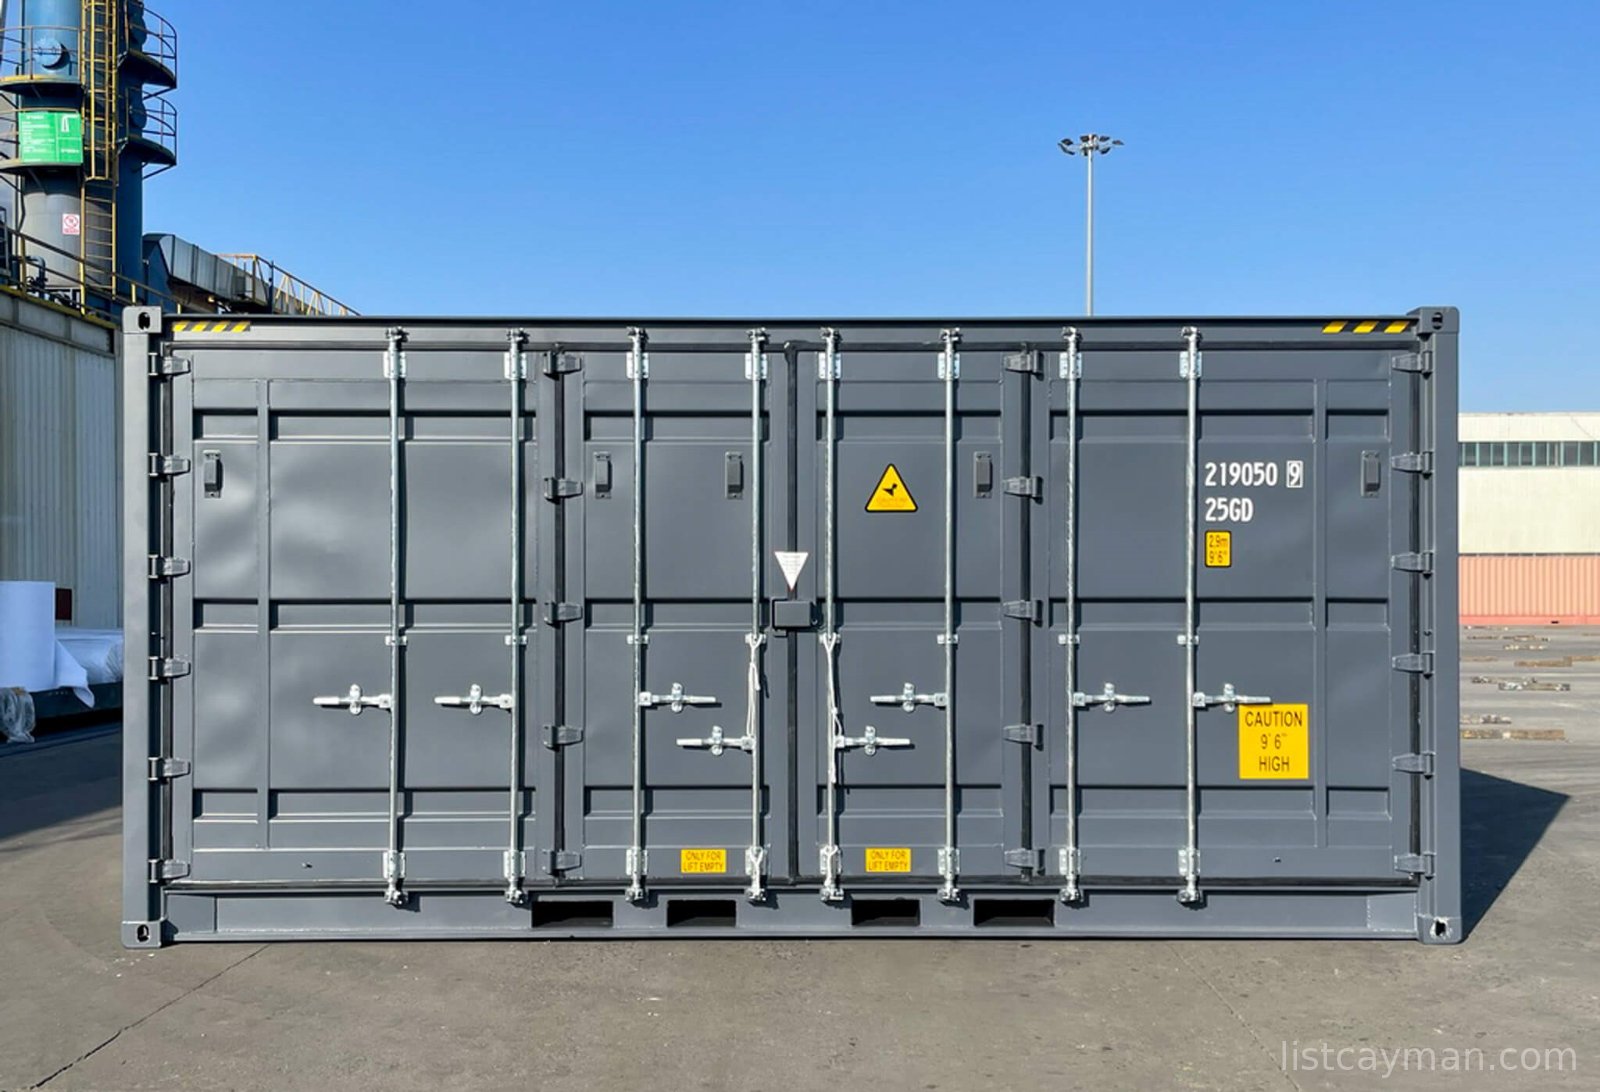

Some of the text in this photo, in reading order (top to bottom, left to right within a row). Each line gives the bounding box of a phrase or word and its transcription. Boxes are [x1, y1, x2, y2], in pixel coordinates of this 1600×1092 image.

[1204, 461, 1302, 487] 219050 9
[1204, 497, 1254, 522] 25GD
[1245, 711, 1303, 727] CAUTION
[1258, 756, 1290, 771] HIGH
[685, 850, 721, 861] ONLY FOR
[870, 849, 906, 860] ONLY FOR
[683, 861, 723, 872] LIFT EMPTY
[868, 860, 908, 871] LIFT EMPTY
